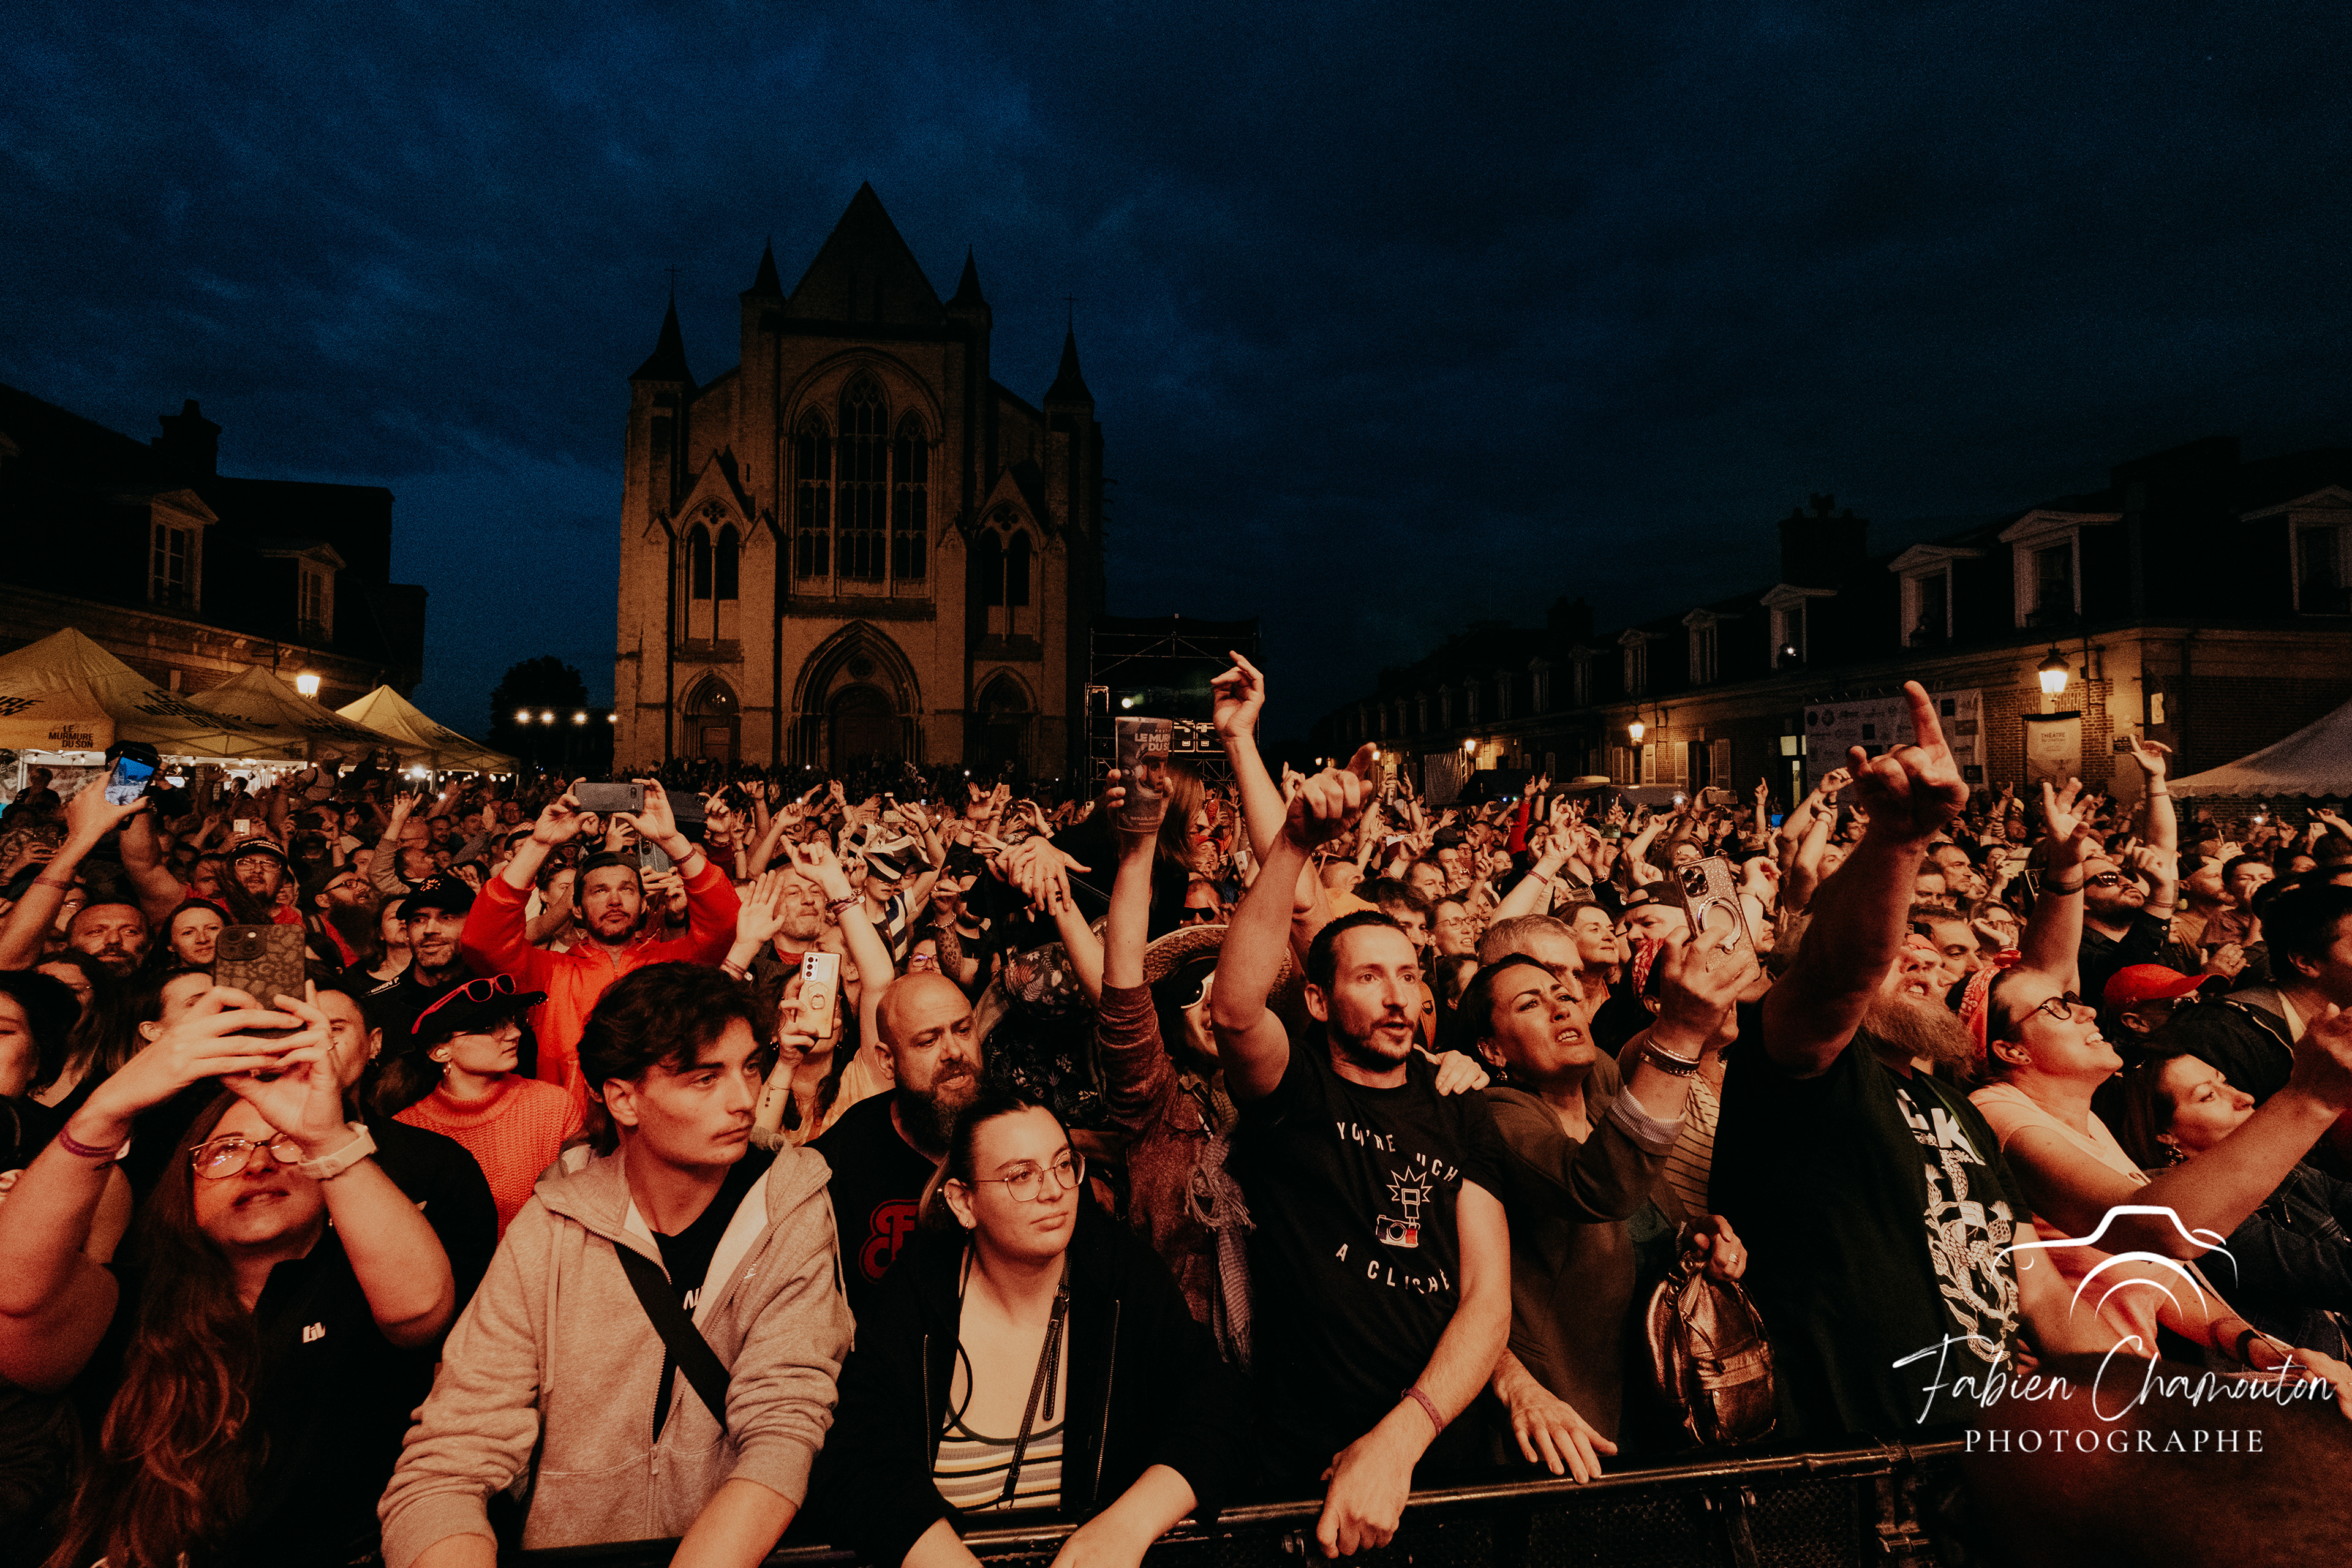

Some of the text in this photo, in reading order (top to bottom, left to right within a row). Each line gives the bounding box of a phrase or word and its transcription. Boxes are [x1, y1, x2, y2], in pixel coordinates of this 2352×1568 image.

[49, 732, 94, 741] MURMURE
[1134, 733, 1170, 743] LE MUR
[1148, 742, 1163, 752] DU
[1335, 1243, 1348, 1262] A
